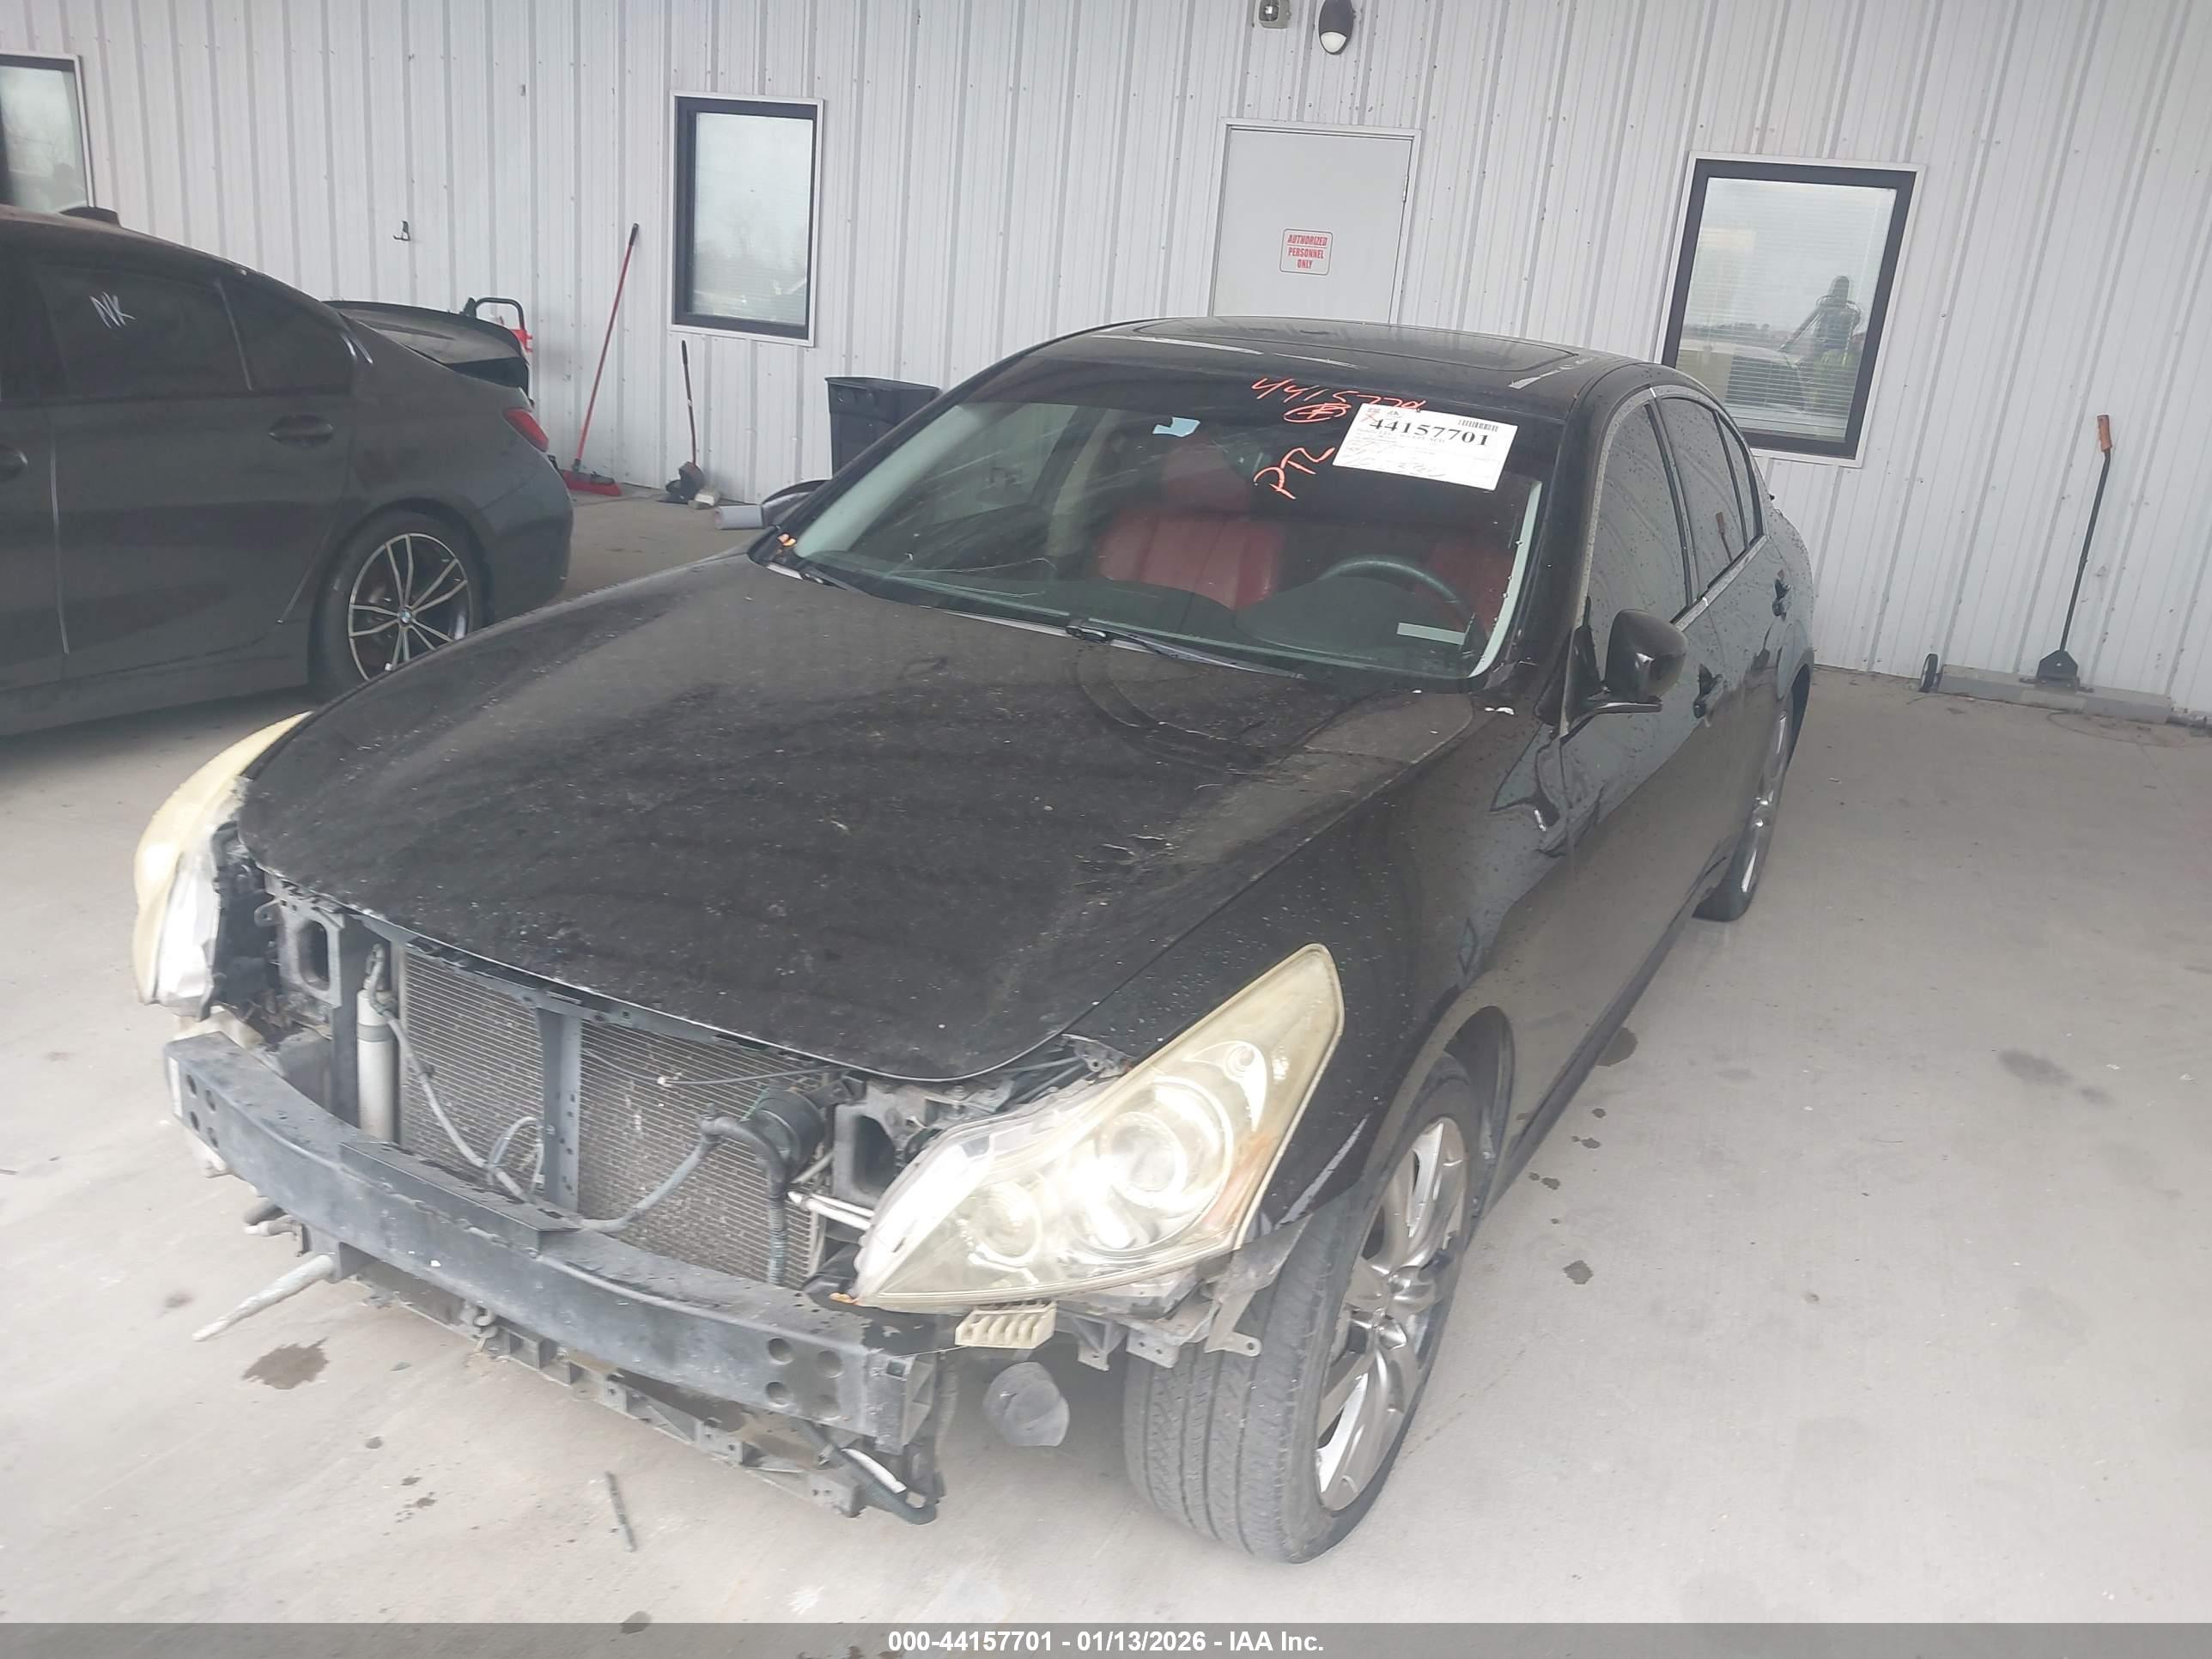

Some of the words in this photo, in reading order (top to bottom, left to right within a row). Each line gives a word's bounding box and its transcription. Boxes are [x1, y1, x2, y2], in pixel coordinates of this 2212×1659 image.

[1287, 234, 1328, 246] AUTHORIZED
[1288, 246, 1324, 259] PERSONNEL
[1297, 258, 1313, 269] ONLY
[1369, 417, 1490, 447] 44157701
